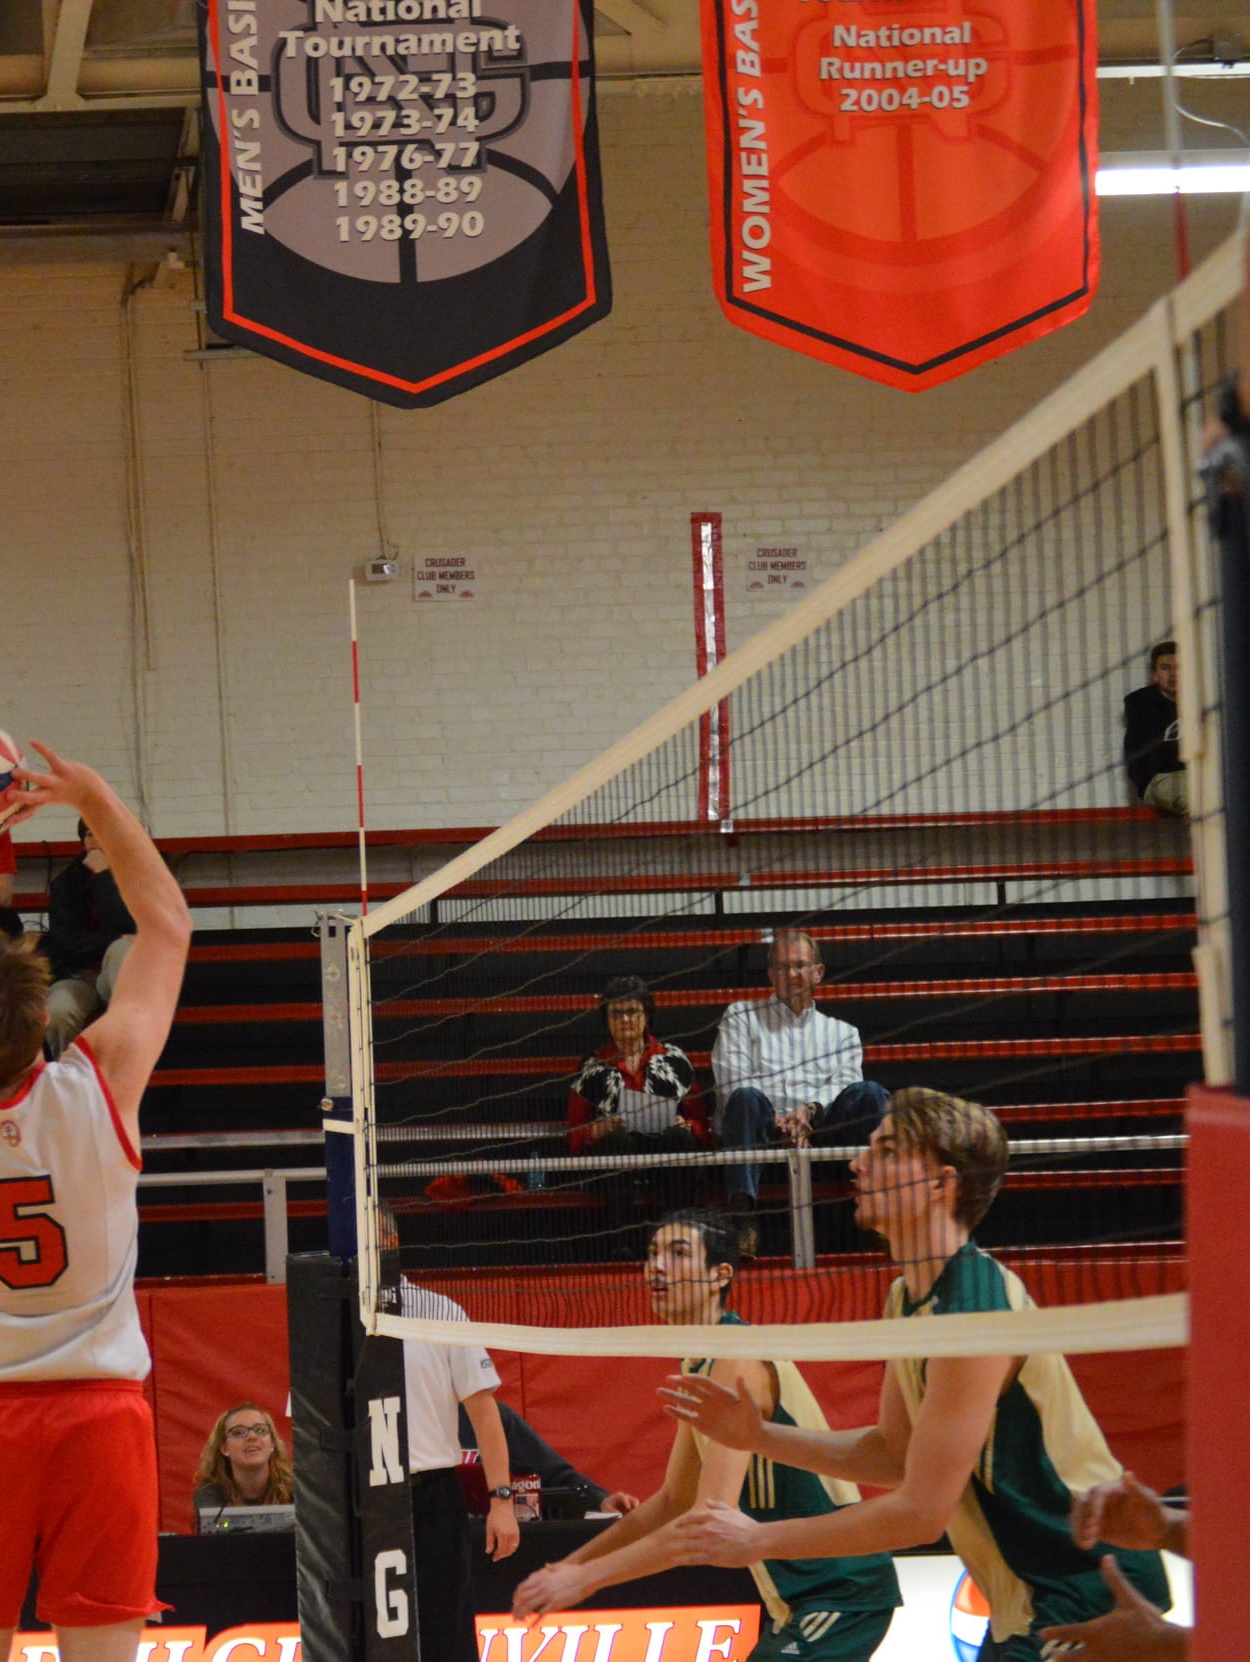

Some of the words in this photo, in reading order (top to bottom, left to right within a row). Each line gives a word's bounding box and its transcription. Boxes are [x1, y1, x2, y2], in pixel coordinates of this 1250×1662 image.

[314, 0, 482, 23] National
[278, 24, 521, 58] Tournament
[832, 21, 971, 48] National
[819, 56, 988, 82] Runner-up
[329, 72, 477, 103] 1972-73
[839, 85, 971, 112] 2004-05
[331, 106, 480, 138] 1973-74
[332, 140, 480, 172] 1976-77
[230, 108, 266, 236] MEN'S
[334, 176, 483, 207] 1988-89
[737, 87, 772, 293] WOMEN'S
[335, 210, 485, 242] 1989-90
[425, 557, 466, 568] CRUSADER
[748, 561, 768, 571] CLUB
[770, 561, 806, 571] MEMBERS
[757, 548, 798, 557] CRUSADER
[416, 571, 437, 581] CLUB
[438, 570, 475, 580] MEMBERS
[436, 584, 456, 593] ONLY
[767, 574, 788, 584] ONLY
[368, 1396, 406, 1487] N
[374, 1549, 410, 1639] G
